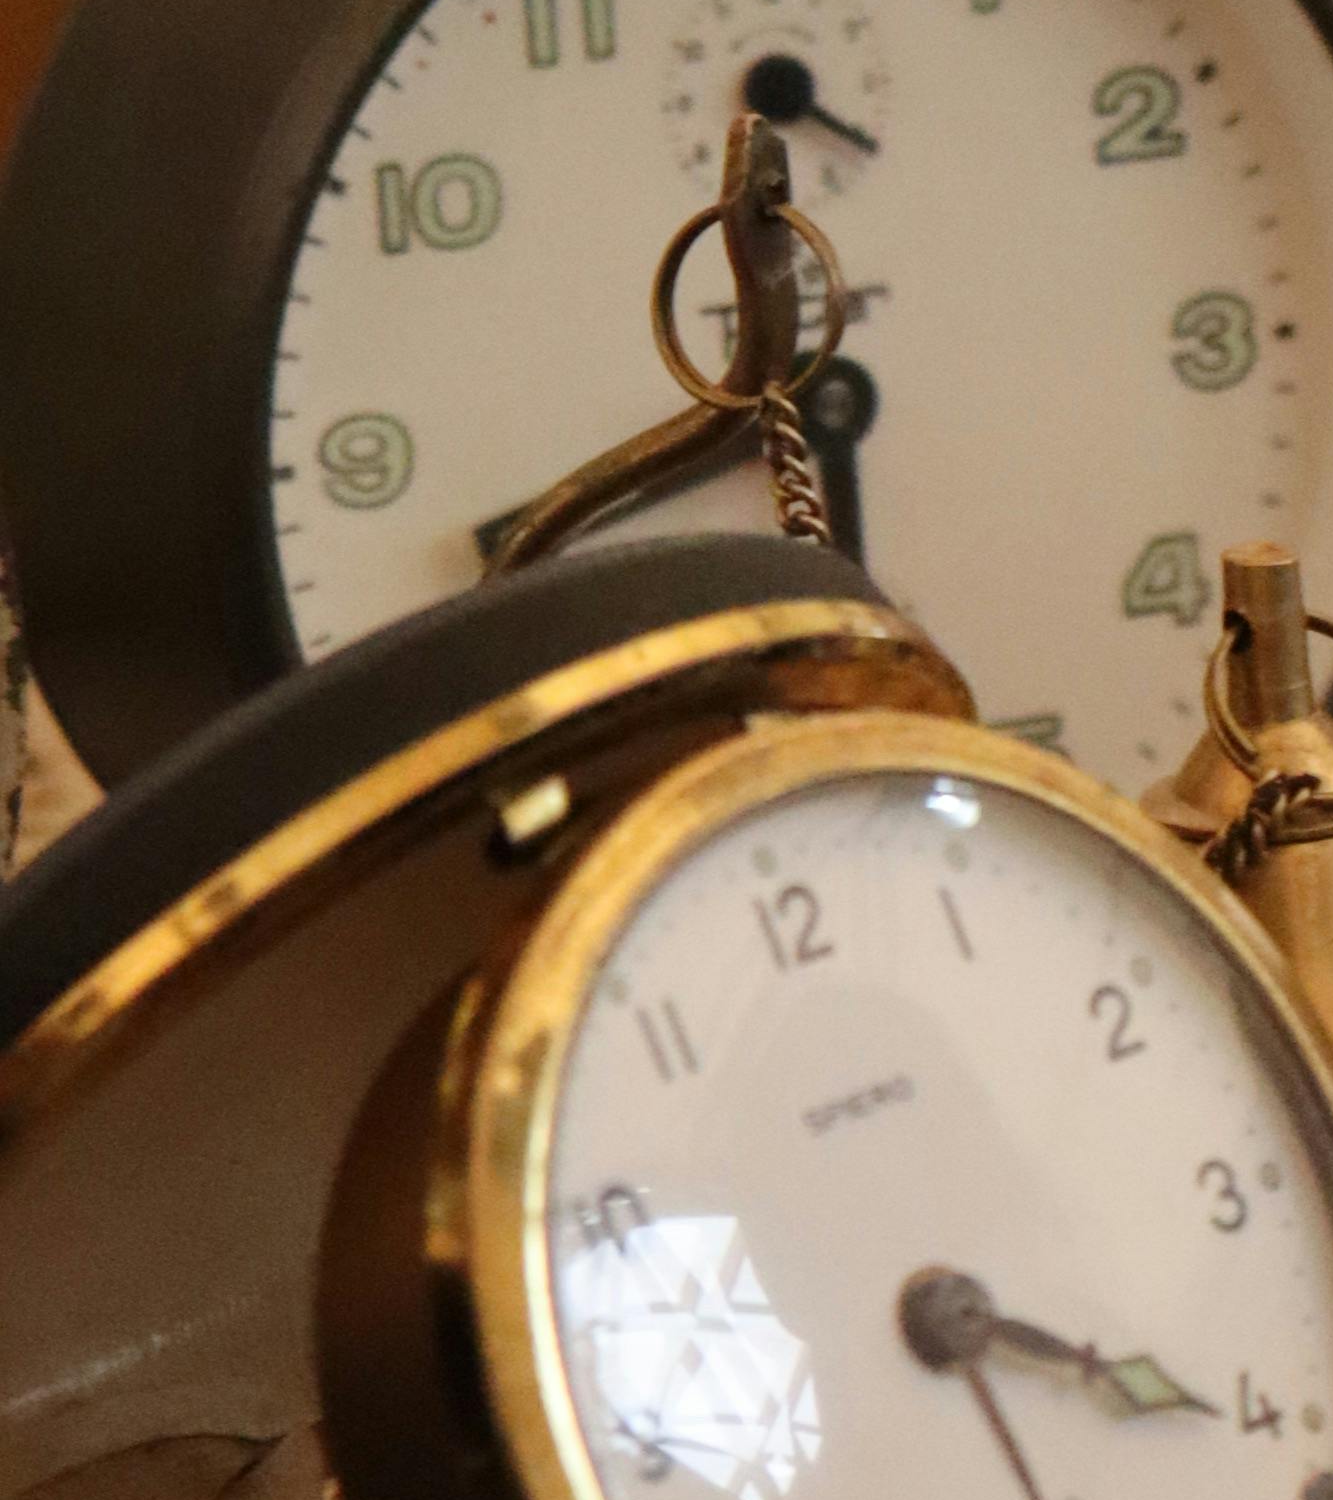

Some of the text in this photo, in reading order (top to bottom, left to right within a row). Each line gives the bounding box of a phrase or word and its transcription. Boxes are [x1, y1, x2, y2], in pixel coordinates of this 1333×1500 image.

[1092, 66, 1187, 167] 2
[375, 153, 504, 255] 10
[1170, 291, 1256, 391] 3
[318, 411, 414, 508] 9
[1122, 533, 1211, 624] 4
[752, 886, 833, 971] 12
[937, 888, 974, 962] 1
[634, 1001, 697, 1081] 11
[1089, 984, 1145, 1063] 2
[1197, 1161, 1248, 1232] 3
[1236, 1374, 1281, 1440] 4
